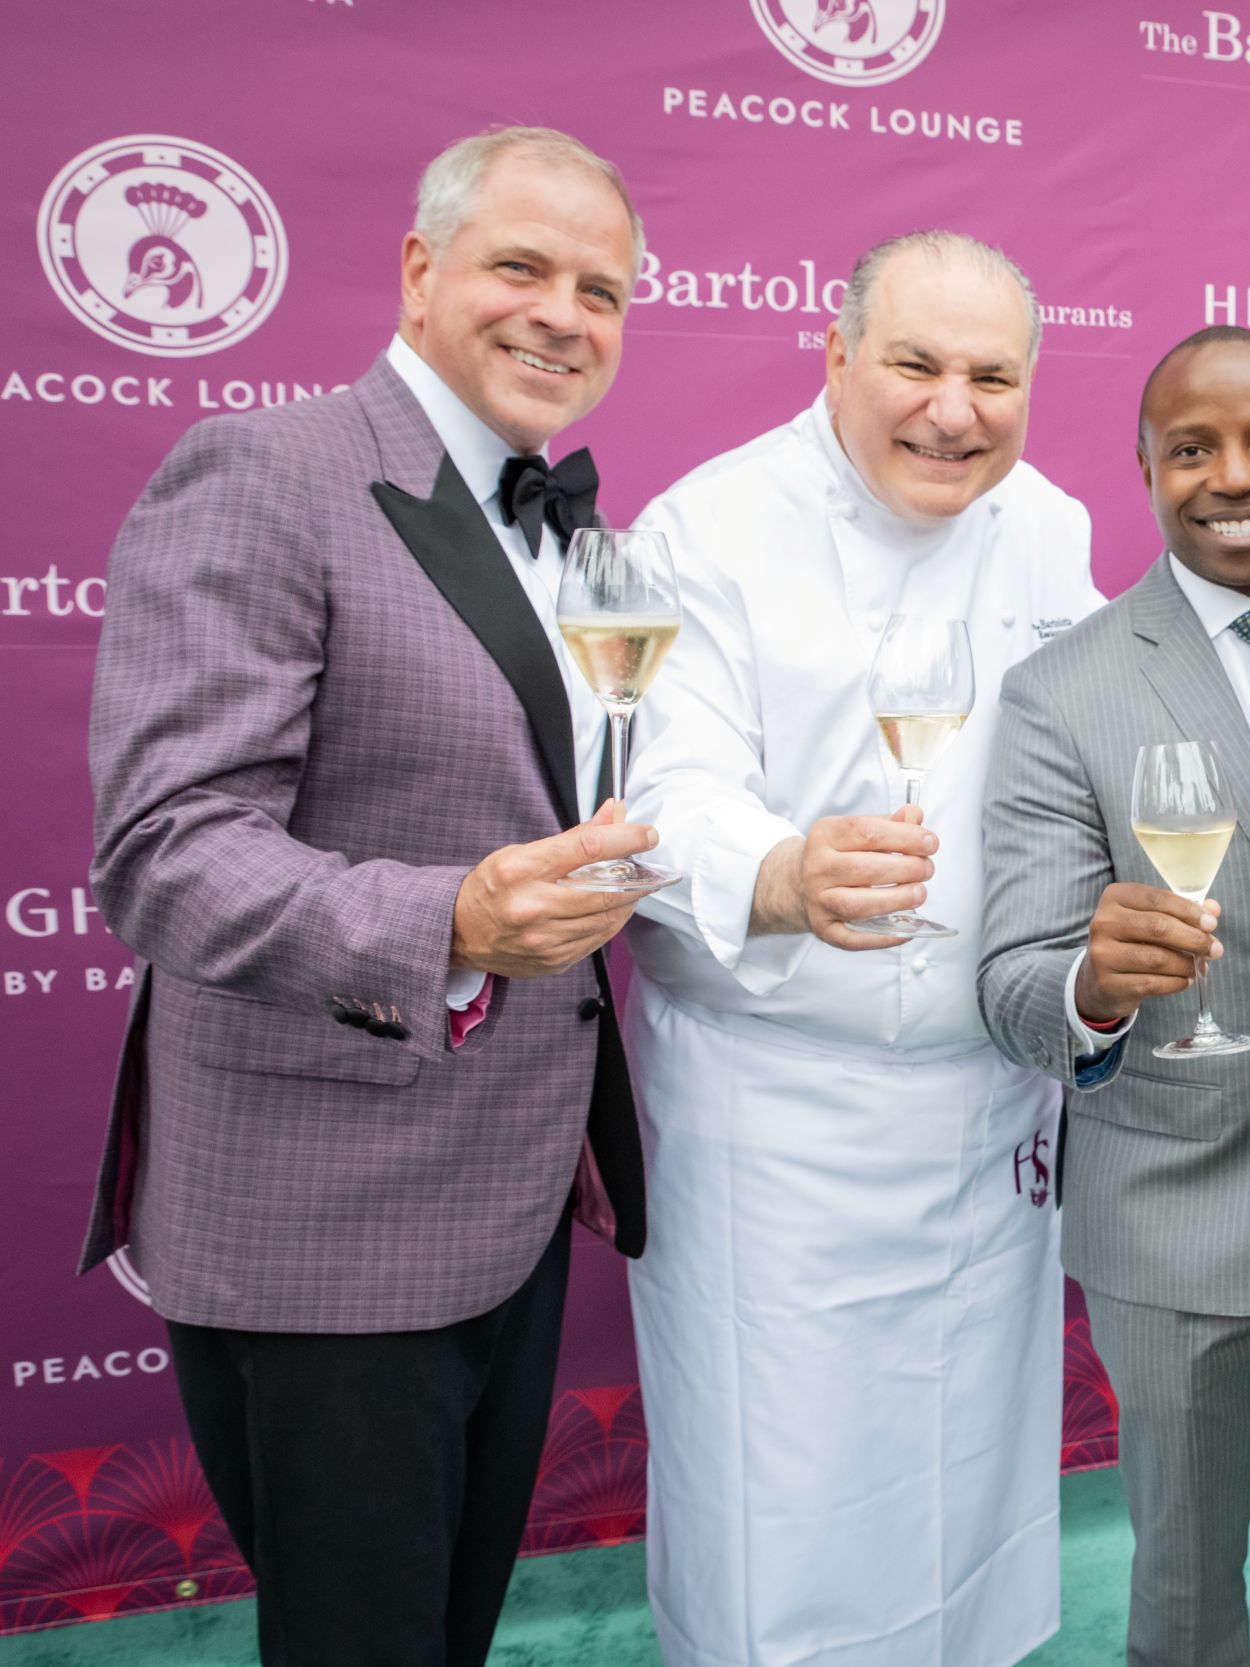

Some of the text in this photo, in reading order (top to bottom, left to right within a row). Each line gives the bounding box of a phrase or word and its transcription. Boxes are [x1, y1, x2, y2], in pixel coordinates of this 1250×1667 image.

[1139, 20, 1198, 55] The
[663, 86, 1022, 146] PEACOCK LOUNGE
[198, 379, 352, 409] LOUN
[4, 969, 58, 995] BY
